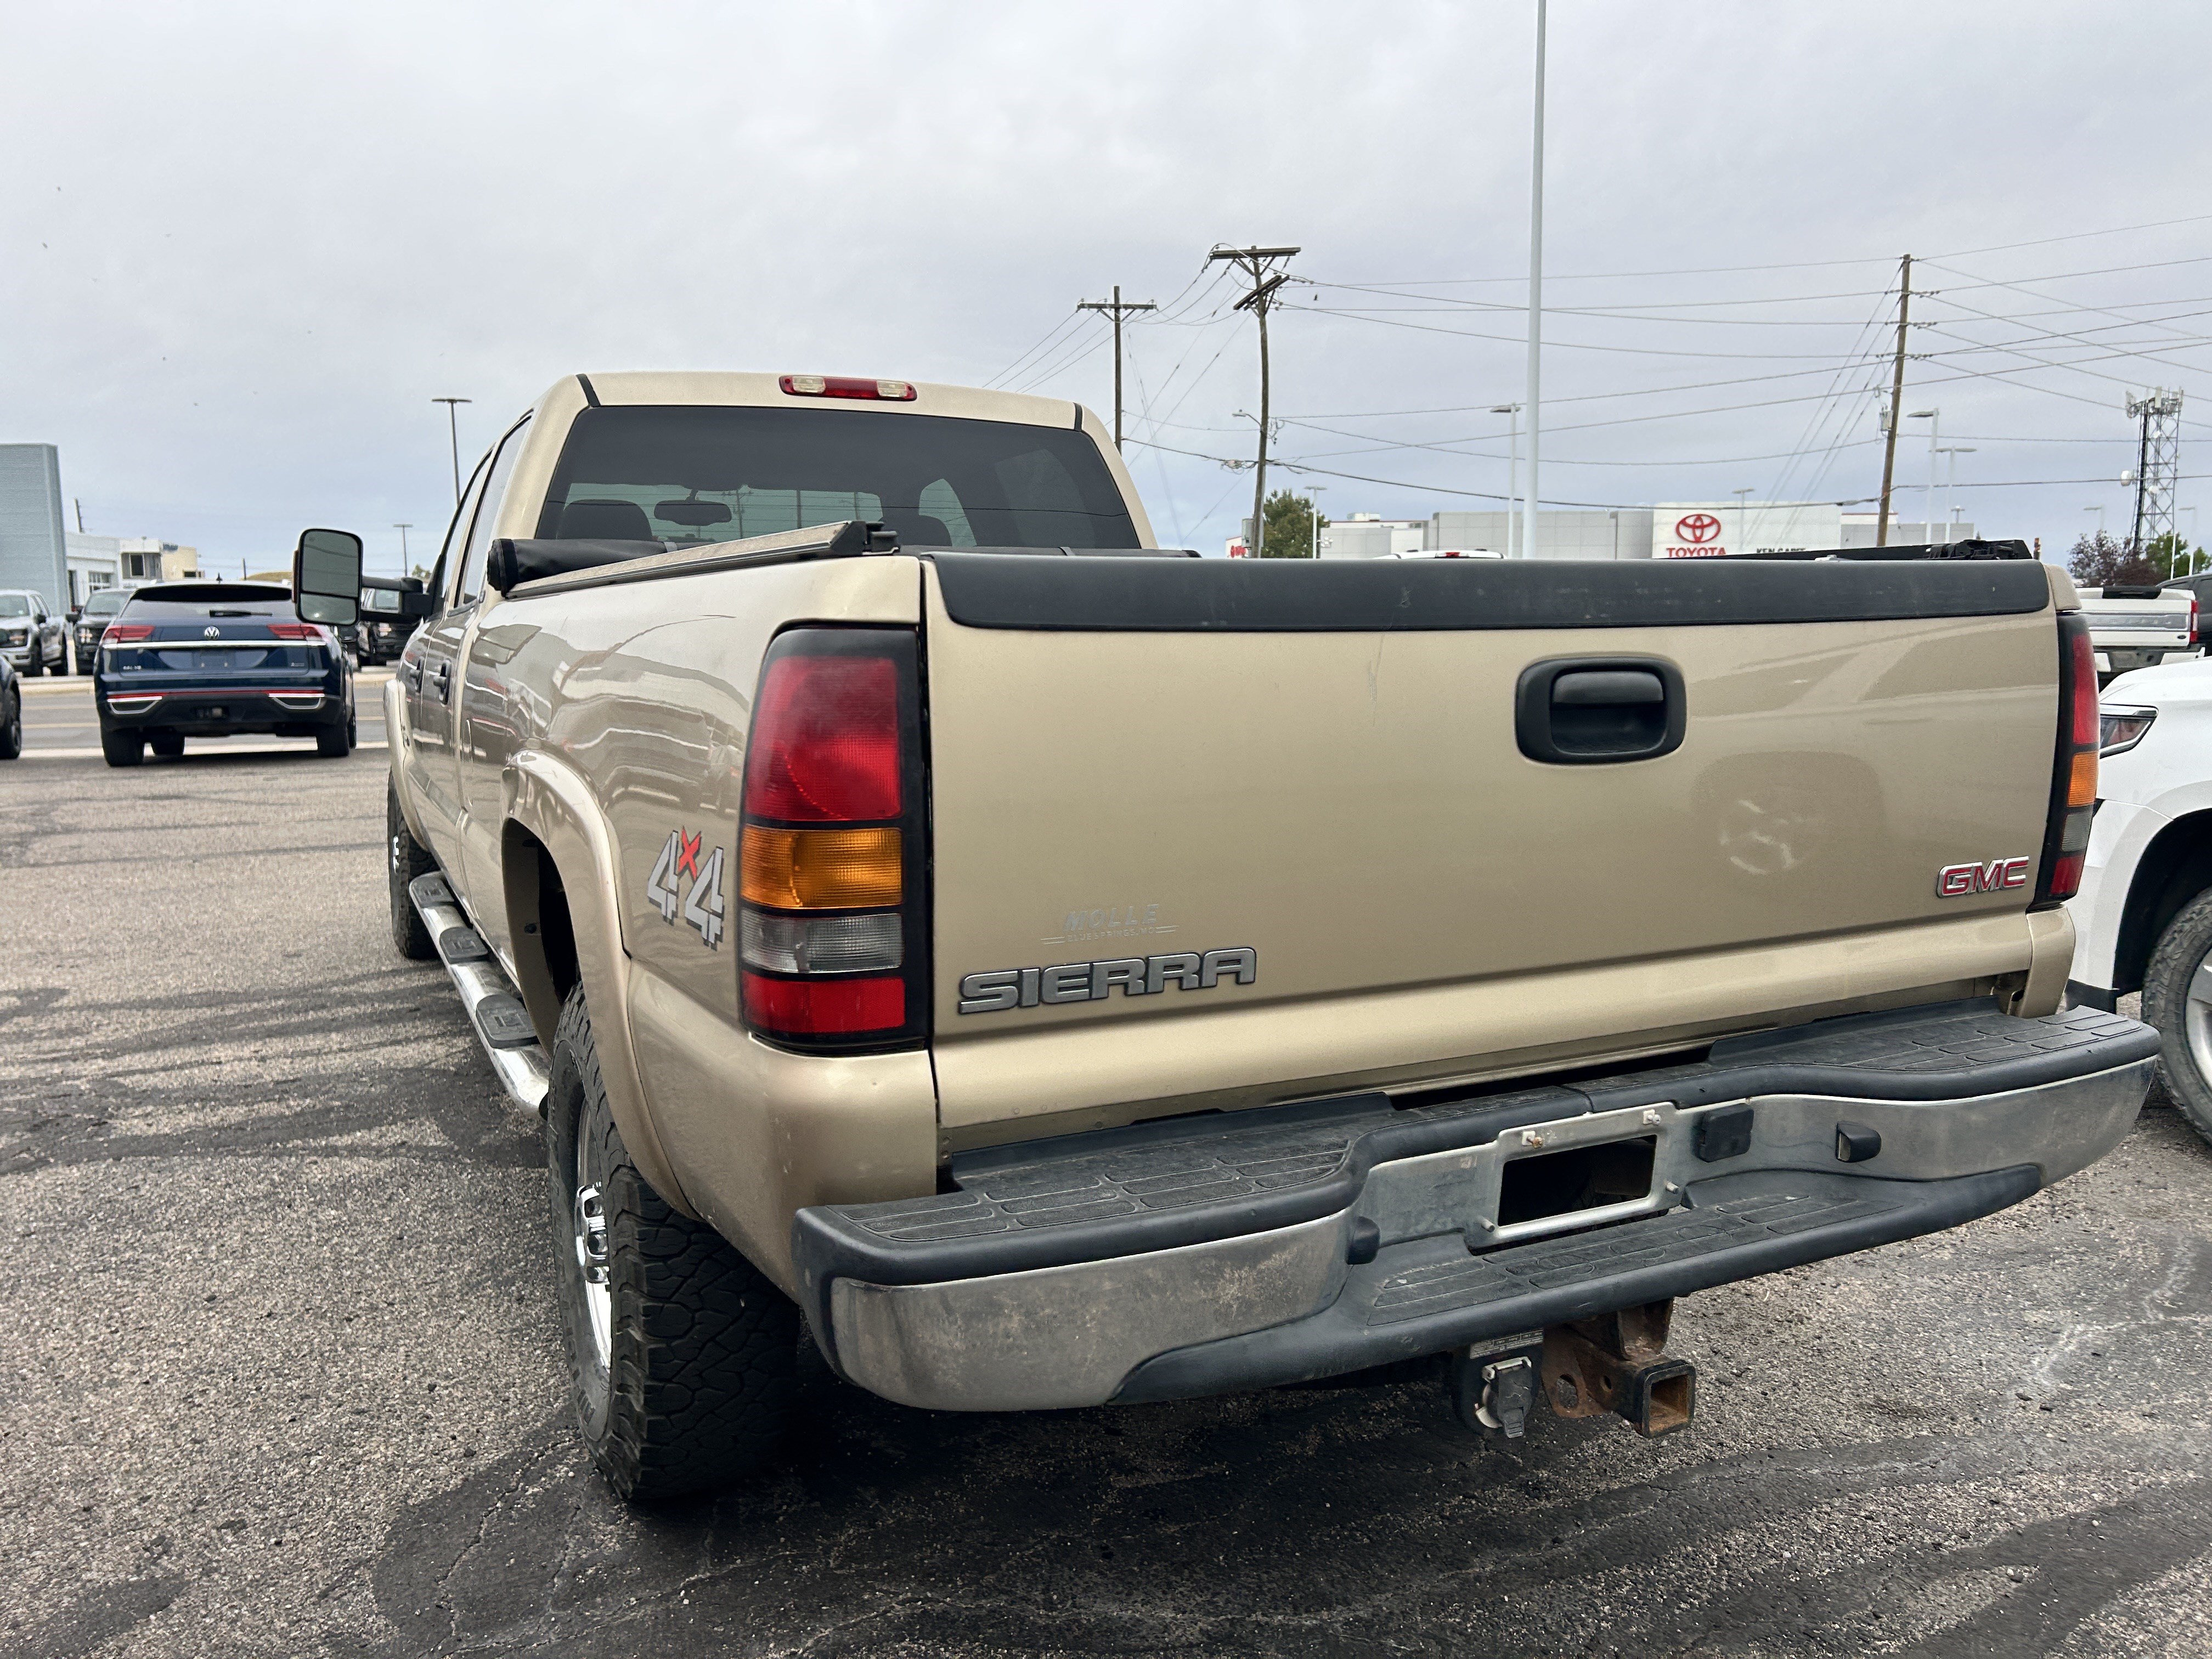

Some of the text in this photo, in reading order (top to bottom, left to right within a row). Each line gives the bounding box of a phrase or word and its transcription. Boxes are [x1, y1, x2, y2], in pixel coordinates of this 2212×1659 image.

[1666, 547, 1726, 557] TOYOTA
[1937, 856, 2029, 898] GMC
[1062, 903, 1159, 932] MOLLE
[958, 947, 1256, 1014] SIERRA
